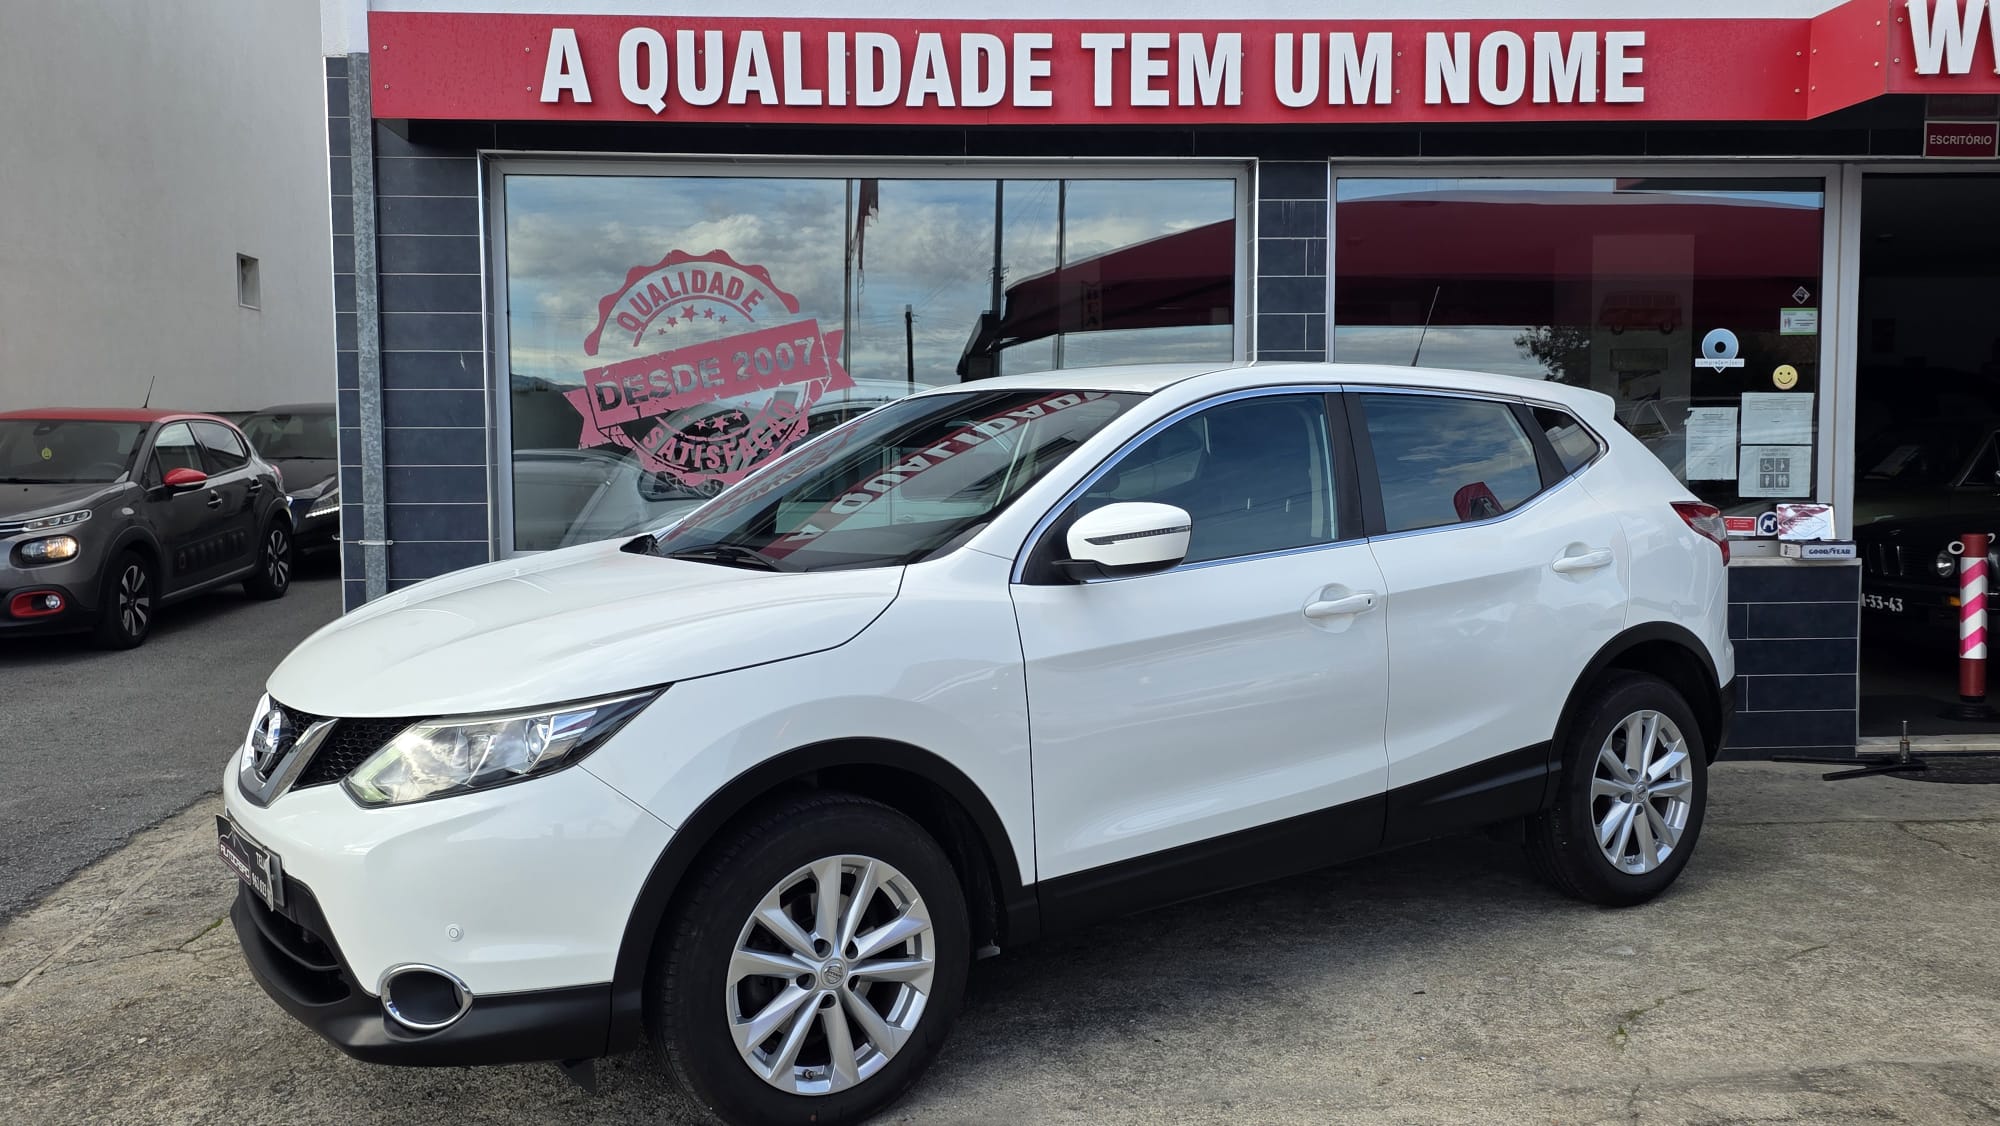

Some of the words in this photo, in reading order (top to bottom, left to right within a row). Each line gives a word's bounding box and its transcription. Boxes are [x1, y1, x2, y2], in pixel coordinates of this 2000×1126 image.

[540, 29, 592, 103] A
[619, 28, 1054, 114] QUALIDADE
[1081, 32, 1242, 106] TEM
[1275, 32, 1393, 107] UM
[1425, 31, 1646, 106] NOME
[1905, 0, 2000, 75] W
[1929, 133, 1993, 145] ESCRITÓRIO
[617, 269, 765, 332] QUALIDADE
[594, 356, 725, 411] DESDE
[732, 336, 816, 382] 2007
